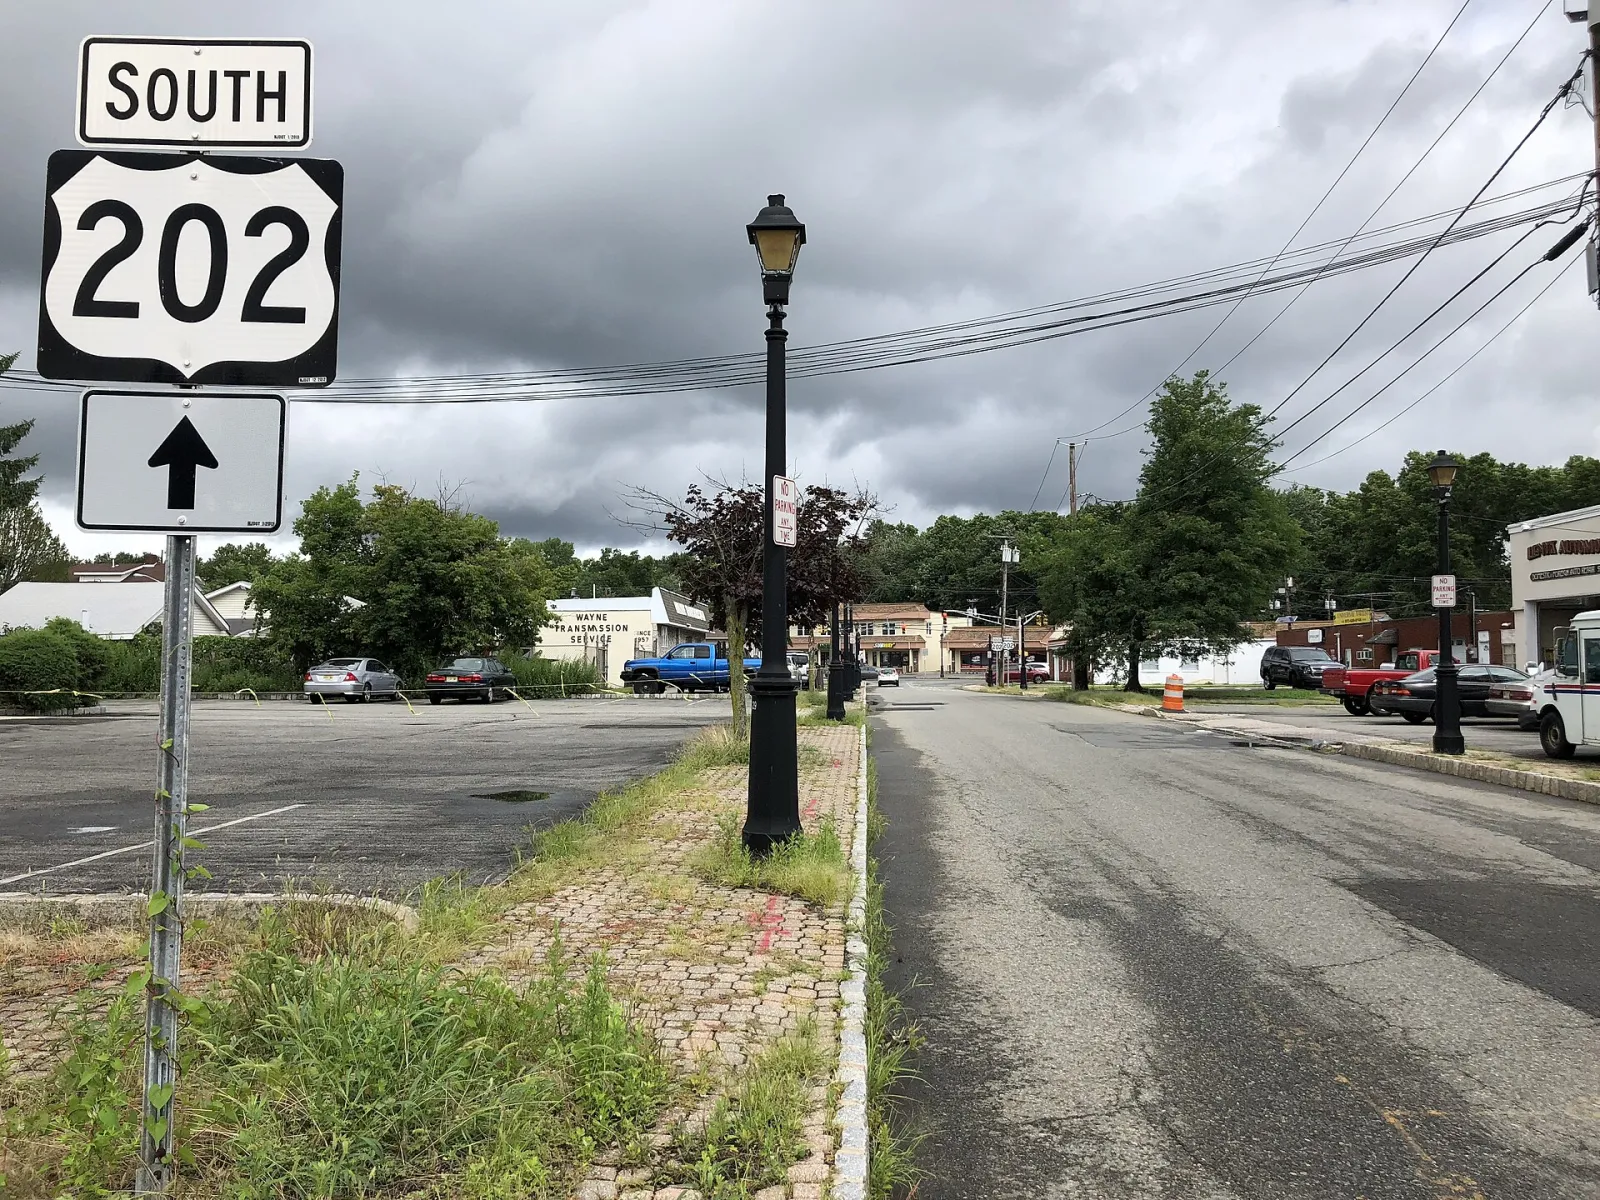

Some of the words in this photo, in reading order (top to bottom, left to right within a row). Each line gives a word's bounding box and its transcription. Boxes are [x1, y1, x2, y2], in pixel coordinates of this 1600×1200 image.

[105, 61, 286, 123] SOUTH
[72, 199, 310, 323] 202
[781, 483, 789, 496] NO
[775, 499, 795, 514] PARKING
[781, 518, 789, 526] ANY
[780, 531, 790, 540] TIME
[576, 613, 608, 621] WAYNE
